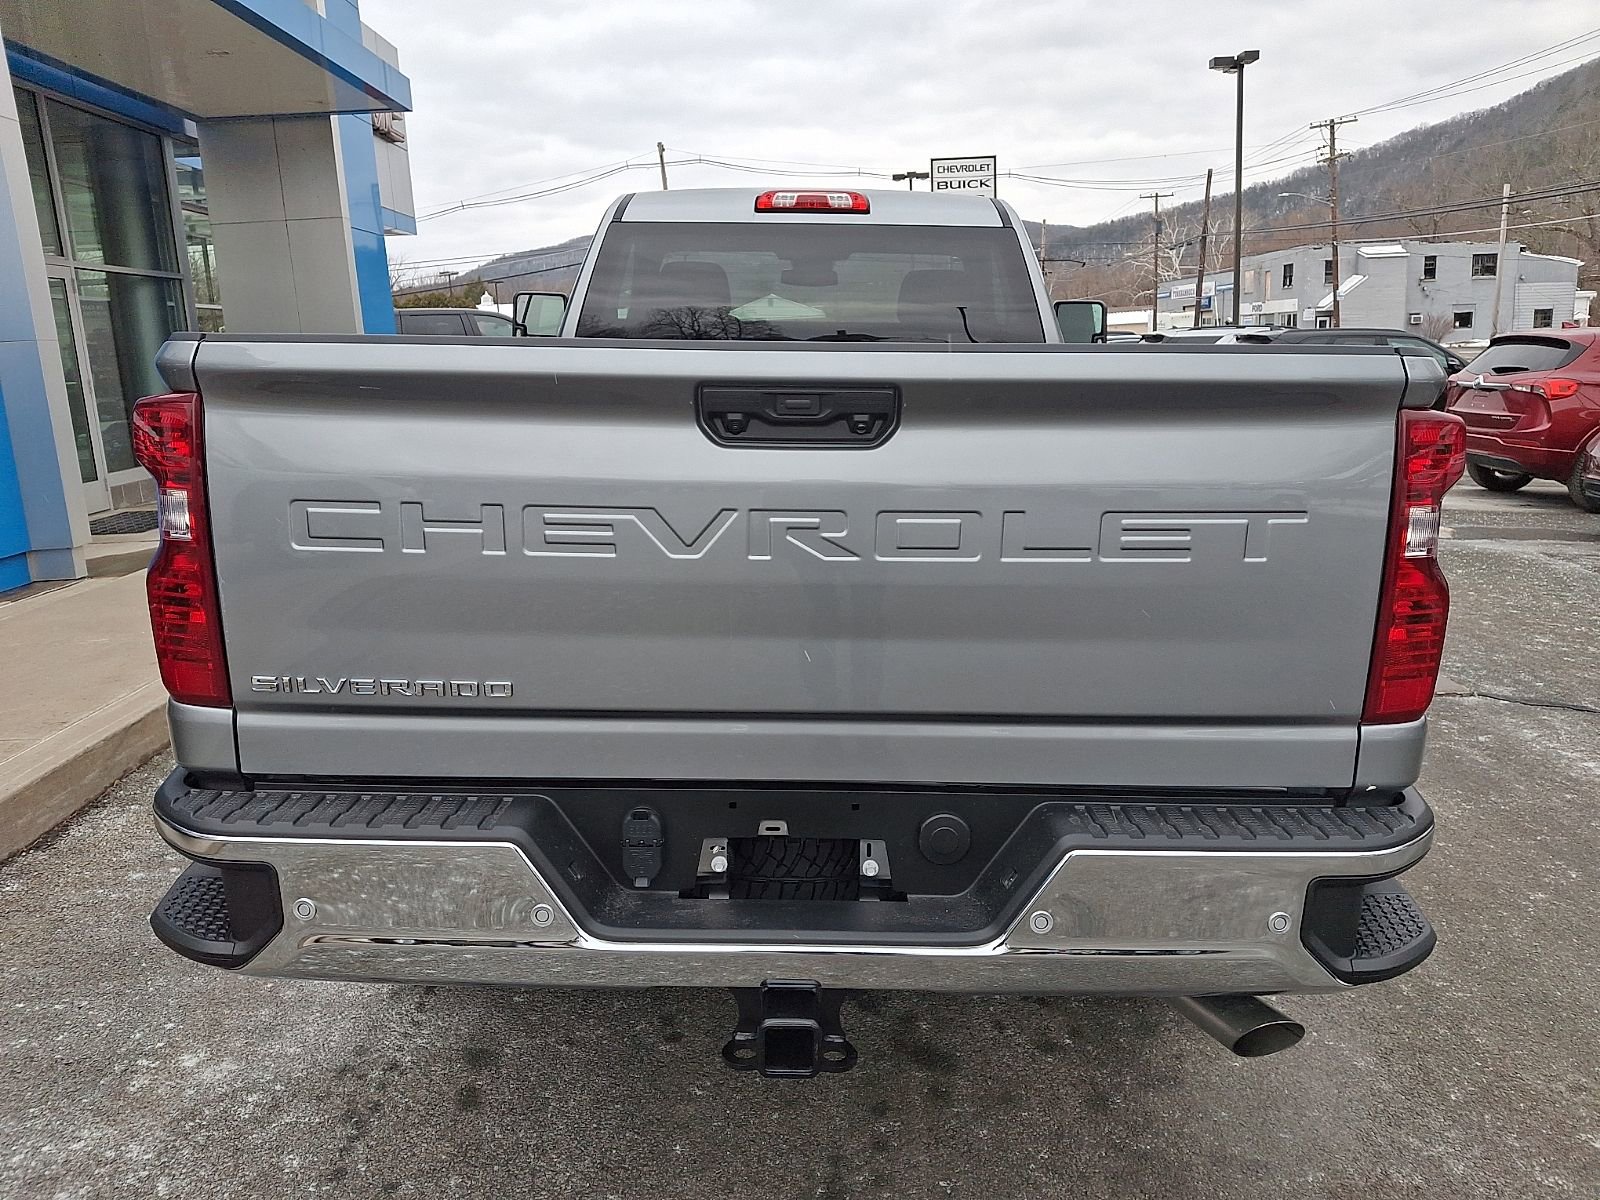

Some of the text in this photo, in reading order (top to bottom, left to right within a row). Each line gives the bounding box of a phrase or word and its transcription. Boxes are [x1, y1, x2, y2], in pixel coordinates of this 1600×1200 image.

[937, 163, 991, 174] CHEVROLET
[937, 179, 992, 190] BUICK
[290, 500, 1309, 564] CHEVROLET
[250, 675, 514, 697] SILVERADO
